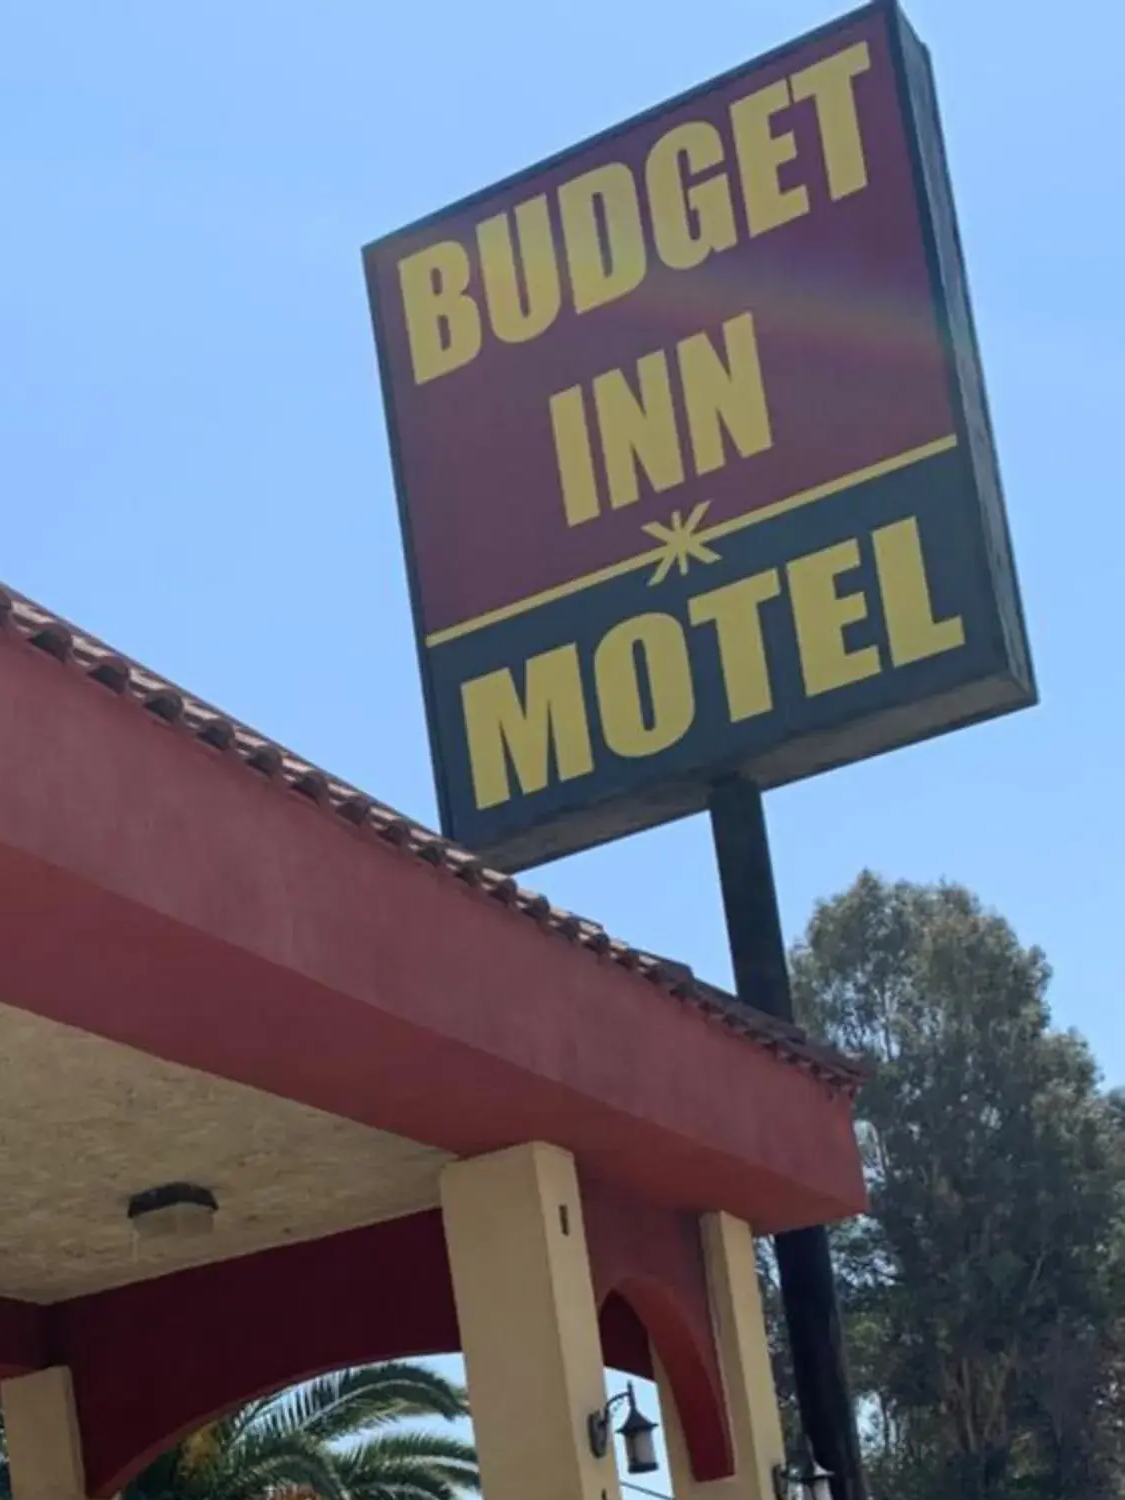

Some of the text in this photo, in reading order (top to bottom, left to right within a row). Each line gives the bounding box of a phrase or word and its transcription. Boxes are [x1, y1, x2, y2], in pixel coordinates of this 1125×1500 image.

[399, 41, 871, 386] BUDGET
[549, 312, 773, 527] INN
[461, 516, 966, 810] MOTEL
